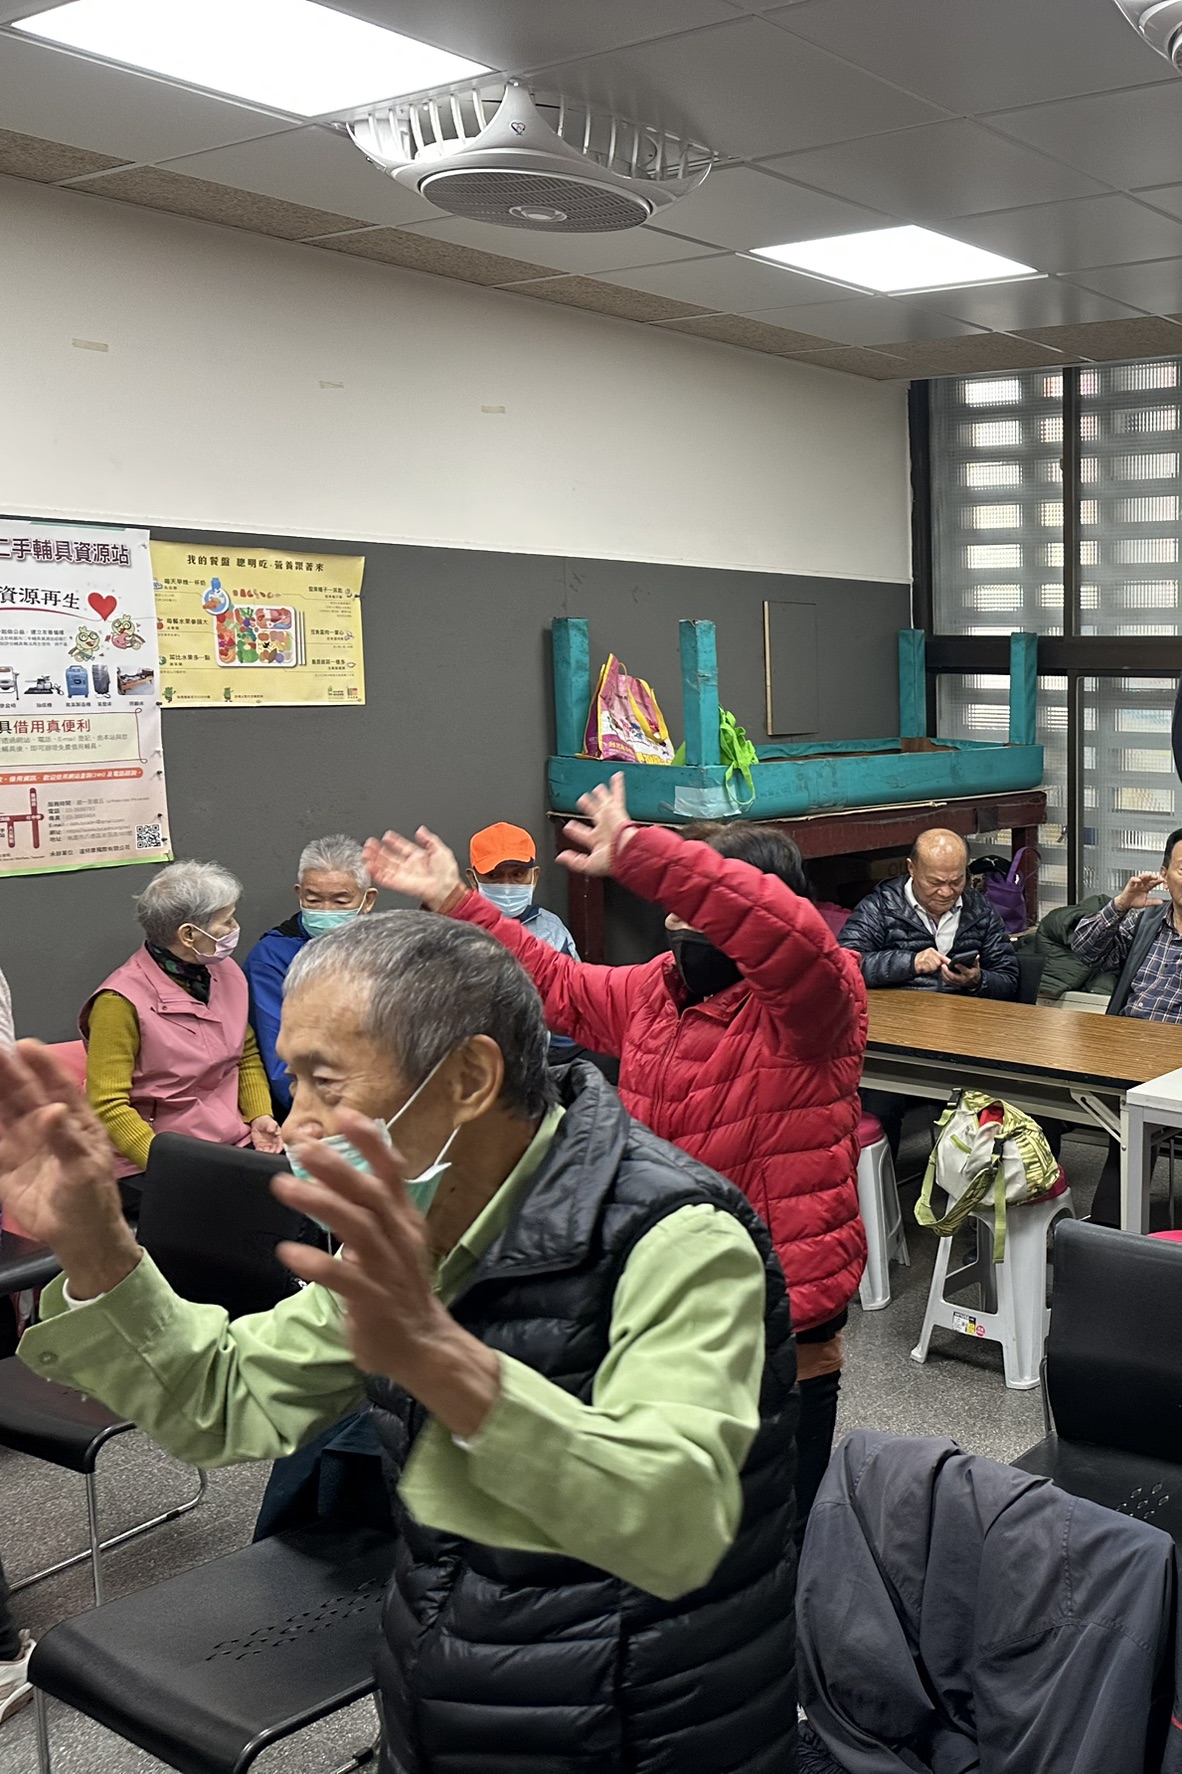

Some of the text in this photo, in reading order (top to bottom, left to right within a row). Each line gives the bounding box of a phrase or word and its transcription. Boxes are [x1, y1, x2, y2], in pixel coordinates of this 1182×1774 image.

[0, 538, 130, 565] 二手輔具資源站
[187, 555, 231, 567] 我的餐盤
[0, 586, 80, 610] 資源再生
[0, 719, 91, 734] 具借用真便利
